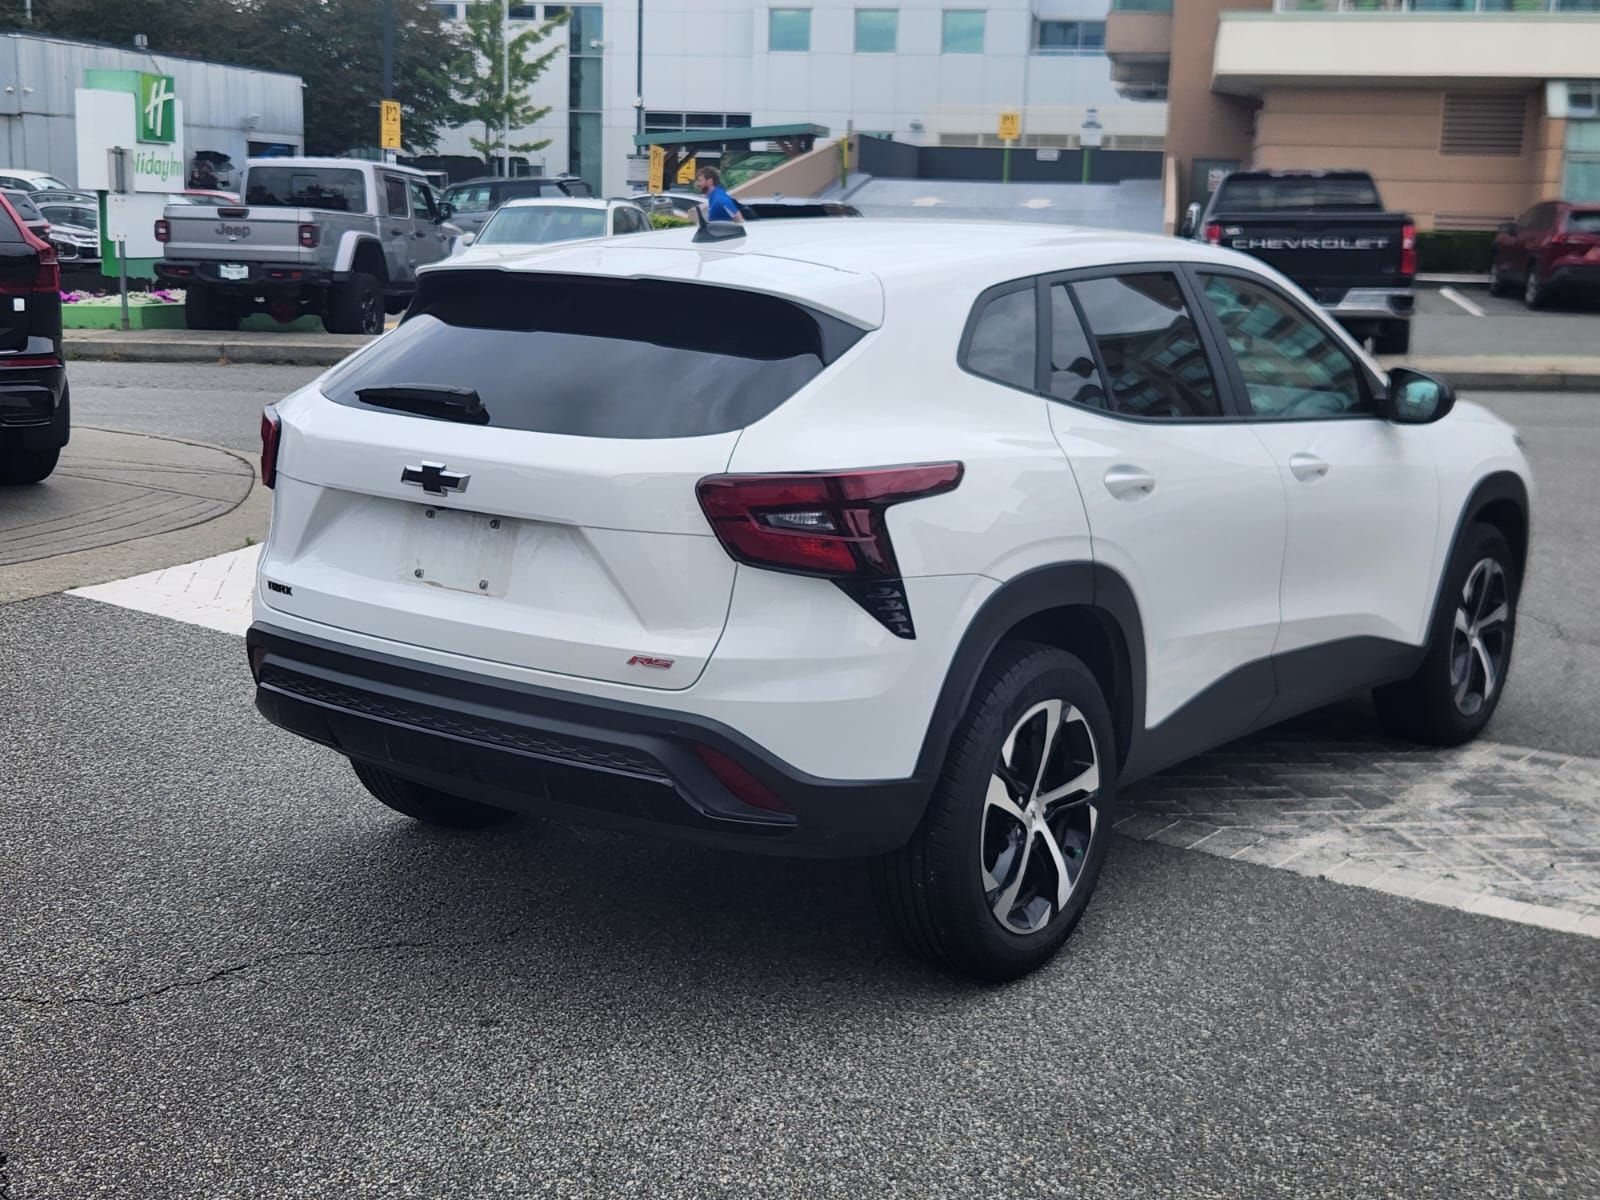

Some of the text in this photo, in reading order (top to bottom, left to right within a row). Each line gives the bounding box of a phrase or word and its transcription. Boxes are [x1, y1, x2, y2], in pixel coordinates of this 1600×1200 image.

[385, 105, 398, 121] P2
[215, 222, 251, 239] Jeep
[1232, 238, 1389, 249] CHEVROLET
[626, 655, 675, 670] RS
